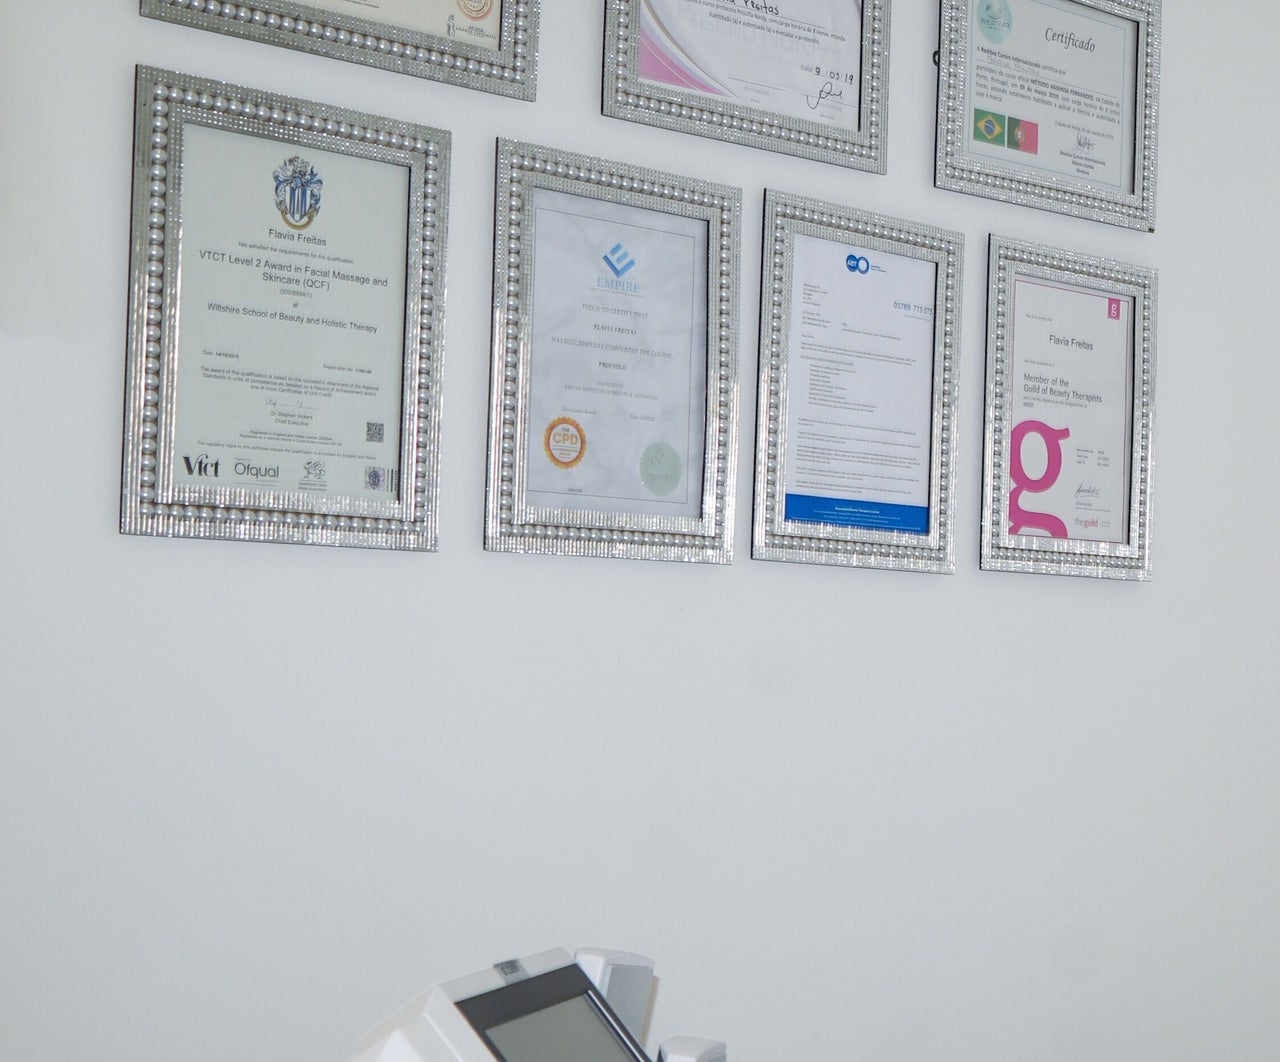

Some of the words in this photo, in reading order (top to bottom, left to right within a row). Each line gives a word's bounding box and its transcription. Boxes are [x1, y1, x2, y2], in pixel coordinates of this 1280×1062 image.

[1045, 27, 1096, 52] Certificado
[269, 229, 294, 241] Flavia
[297, 234, 327, 246] Freitas
[200, 250, 225, 262] VTCT
[229, 254, 253, 266] Level
[256, 258, 261, 268] 2
[264, 260, 292, 273] Award
[295, 264, 302, 274] in
[305, 266, 330, 278] Facial
[332, 270, 370, 286] Massage
[372, 276, 388, 287] and
[262, 272, 300, 286] Skincare
[303, 278, 330, 291] (QCF)
[596, 277, 640, 293] EMPIRE
[208, 303, 240, 314] Wiltshire
[242, 308, 268, 318] School
[270, 311, 278, 319] of
[279, 313, 304, 324] Beauty
[306, 317, 320, 325] and
[322, 318, 347, 329] Holistic
[350, 322, 377, 334] Therapy
[594, 324, 613, 332] FLAVIA
[615, 326, 637, 335] FREITAS
[1049, 335, 1069, 347] Flavia
[1071, 338, 1093, 350] Freitas
[1024, 373, 1050, 384] Member
[1052, 377, 1058, 385] of
[1060, 378, 1069, 387] the
[1024, 384, 1040, 394] Guild
[1042, 386, 1048, 395] of
[1050, 388, 1070, 400] Beauty
[1072, 391, 1102, 403] Therapists
[553, 432, 578, 446] CPD
[234, 462, 279, 479] Ofqual
